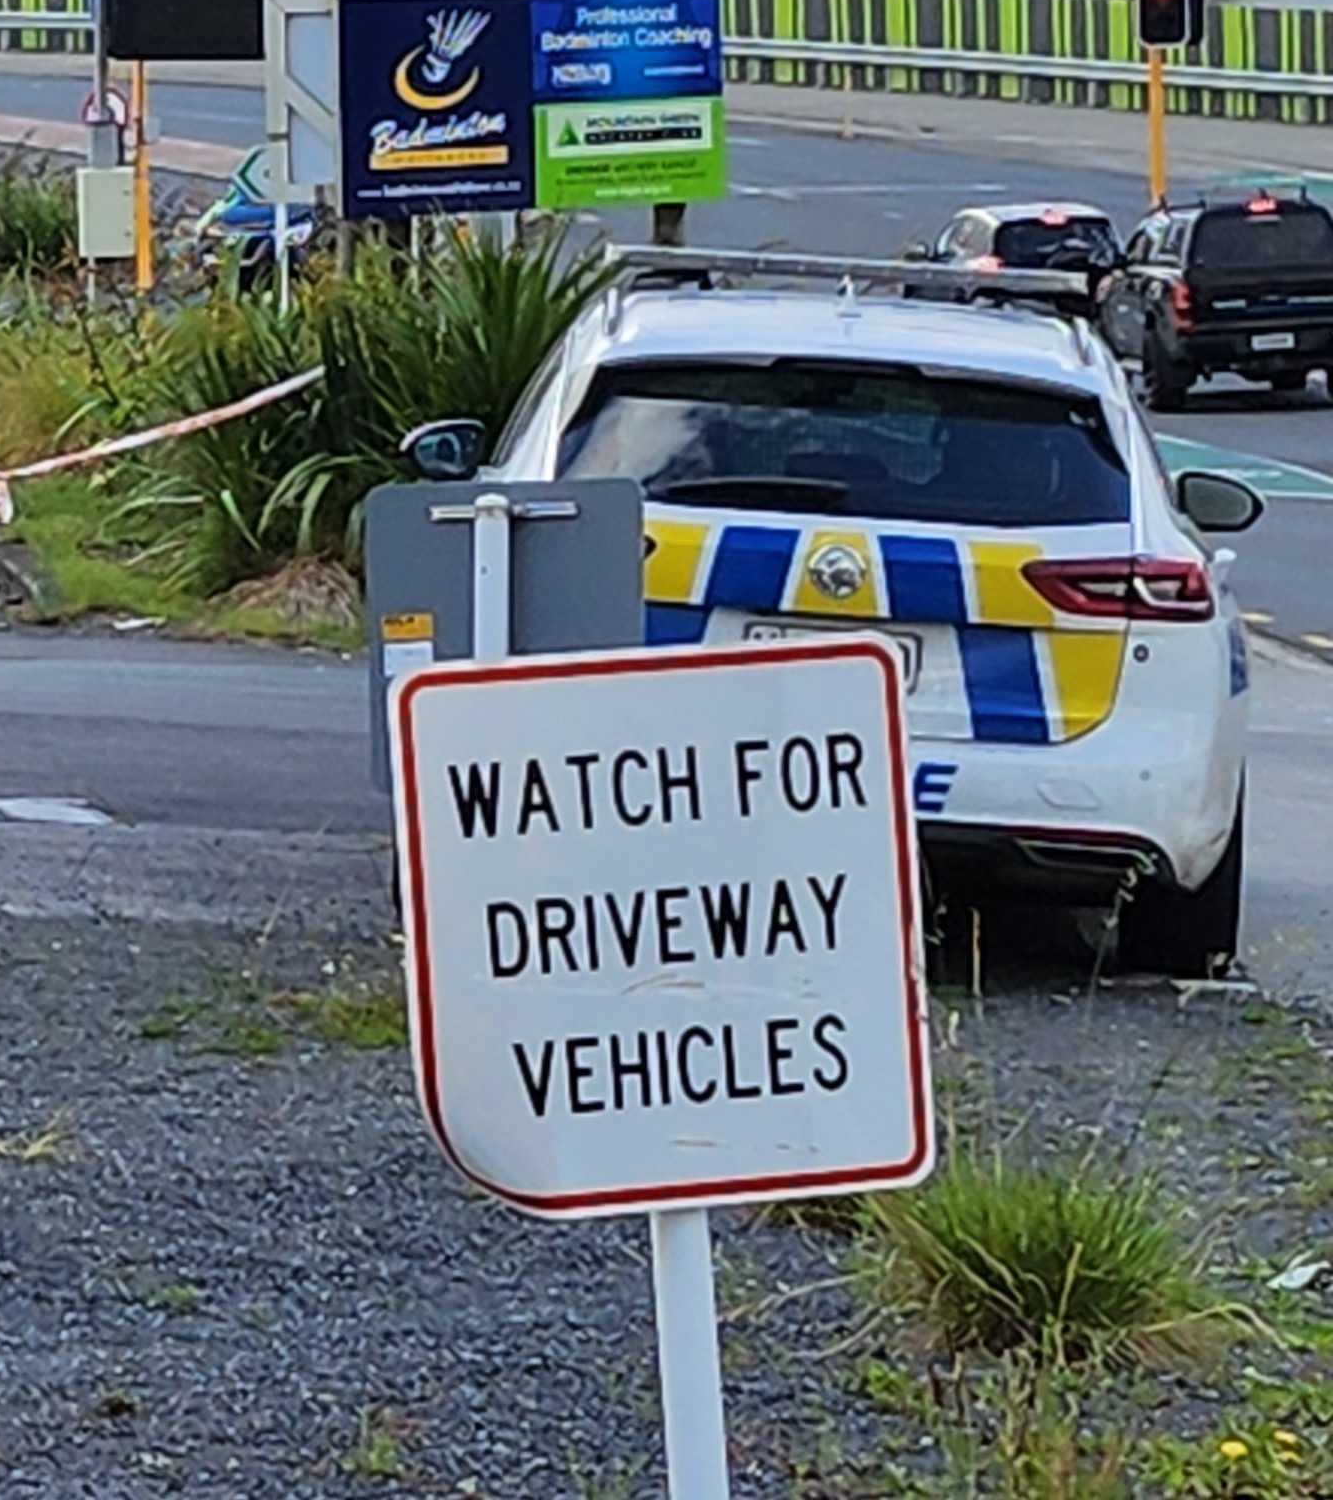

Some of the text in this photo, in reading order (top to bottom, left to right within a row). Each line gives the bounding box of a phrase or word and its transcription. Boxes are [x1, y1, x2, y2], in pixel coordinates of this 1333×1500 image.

[635, 25, 712, 49] Coaching
[448, 733, 868, 839] WATCH FOR
[485, 874, 850, 978] DRIVEWAY
[513, 1014, 850, 1117] VEHICLES
